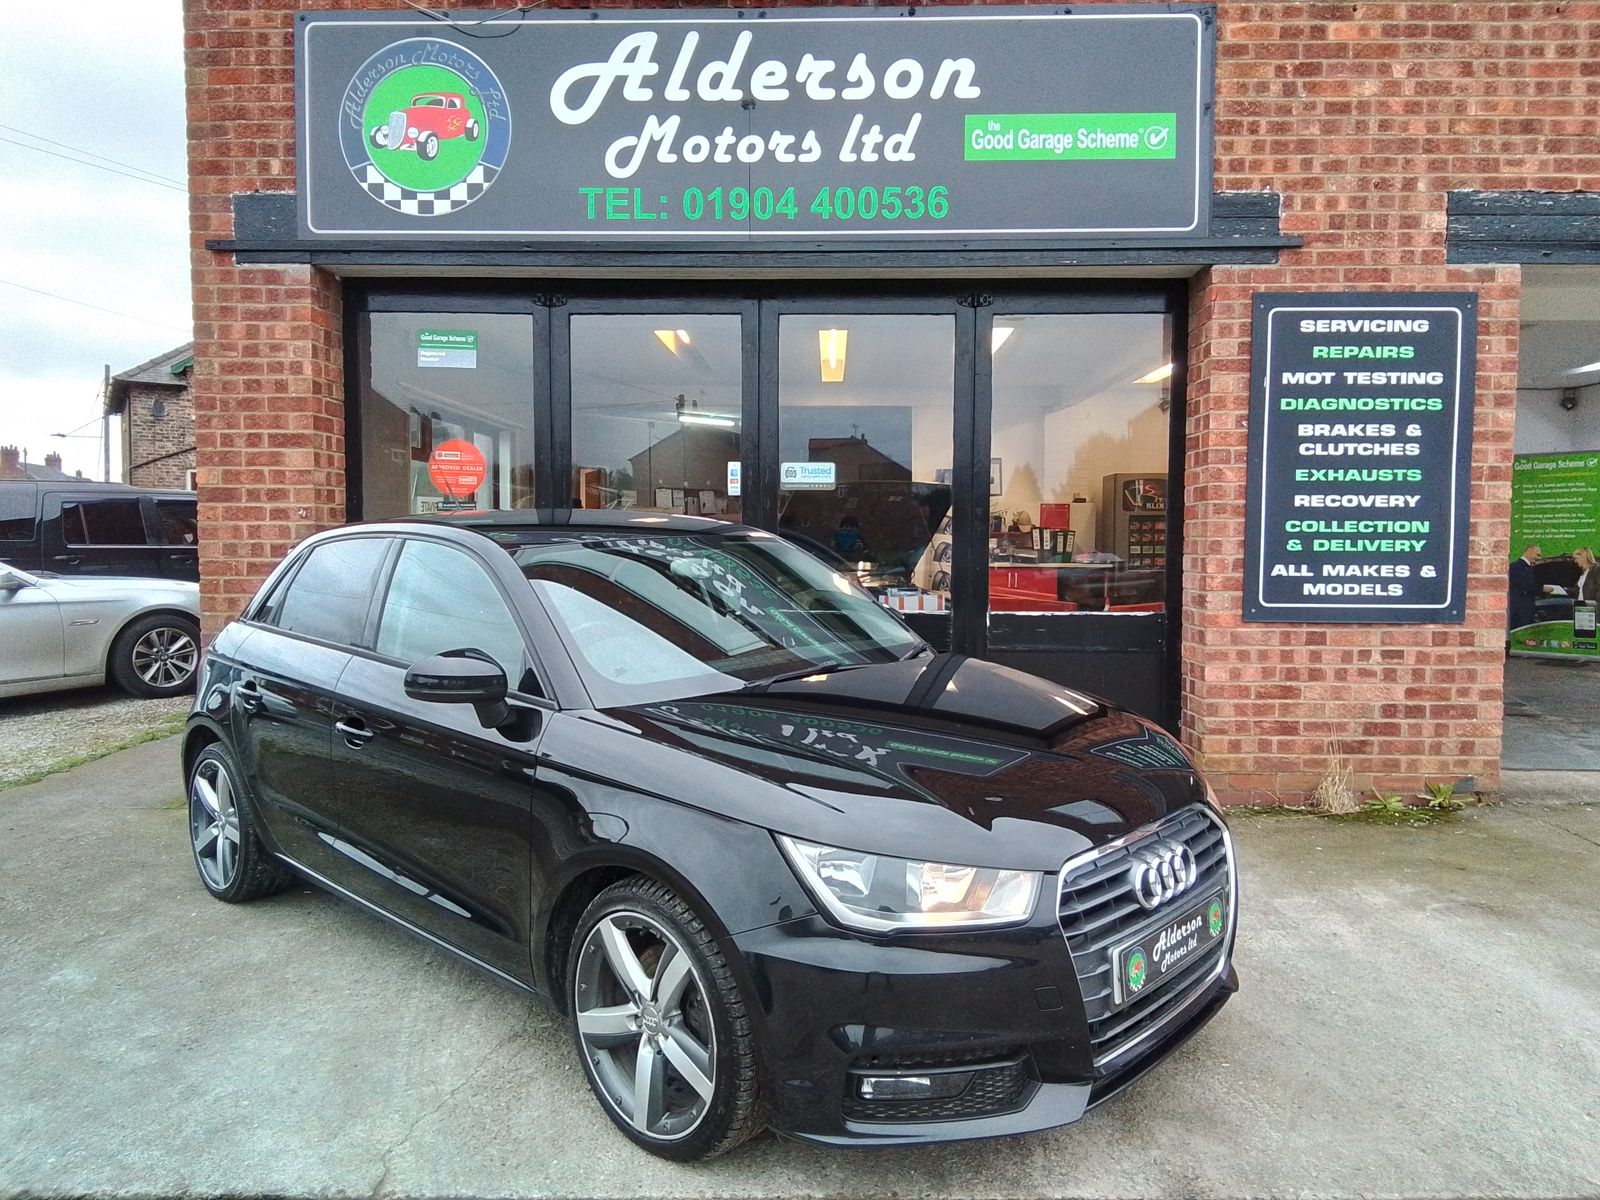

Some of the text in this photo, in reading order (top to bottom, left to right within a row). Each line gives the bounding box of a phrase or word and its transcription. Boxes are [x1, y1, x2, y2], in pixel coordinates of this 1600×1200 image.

[550, 30, 982, 125] Alderson
[345, 54, 407, 129] Alderson
[412, 43, 479, 80] Motors
[988, 120, 1000, 131] the
[604, 114, 822, 179] Motors
[971, 128, 1139, 154] Good Garage Scheme
[578, 185, 950, 220] TEL: 01904 400536
[1300, 319, 1429, 333] SERVICING
[1312, 346, 1415, 359] REPAIRS
[1282, 372, 1444, 385] MOT TESTING
[1280, 398, 1443, 411] DIAGNOSTICS
[1298, 424, 1422, 437] BRAKES &
[1299, 443, 1420, 456] CLUTCHES
[799, 466, 832, 475] Trusted
[1533, 461, 1557, 471] Garage
[1558, 460, 1585, 469] Scheme
[1295, 469, 1422, 482] EXHAUSTS
[1294, 495, 1421, 508] RECOVERY
[1285, 520, 1430, 533] COLLECTION
[1286, 539, 1427, 552] & DELIVERY
[1270, 564, 1437, 578] ALL MAKES &
[1303, 583, 1403, 596] MODELS
[1153, 915, 1203, 962] Alderson
[1161, 945, 1187, 973] Motors
